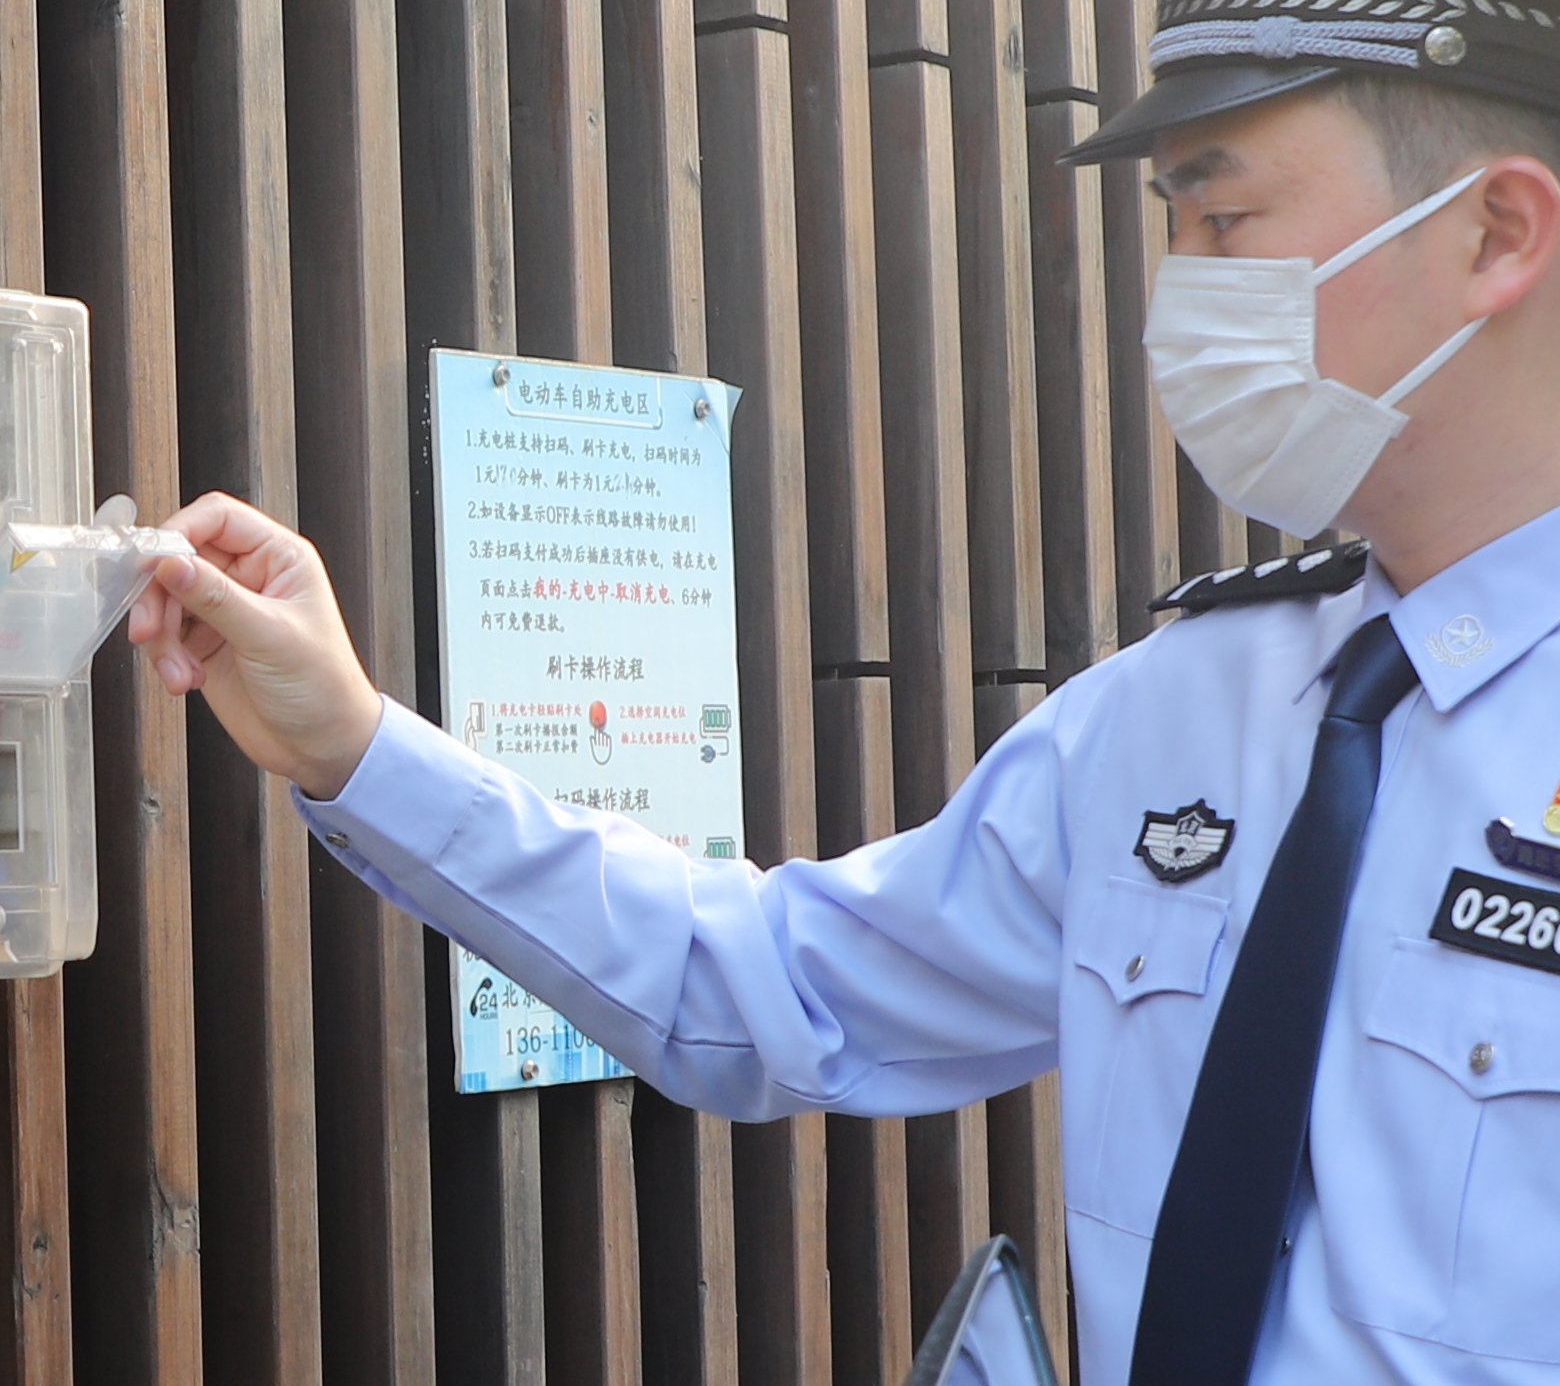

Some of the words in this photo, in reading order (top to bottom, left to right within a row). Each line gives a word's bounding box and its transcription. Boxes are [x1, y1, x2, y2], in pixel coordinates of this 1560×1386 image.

[518, 379, 650, 416] 电动车自助充电区
[546, 654, 645, 682] 刷卡操作流程
[479, 993, 498, 1012] 24
